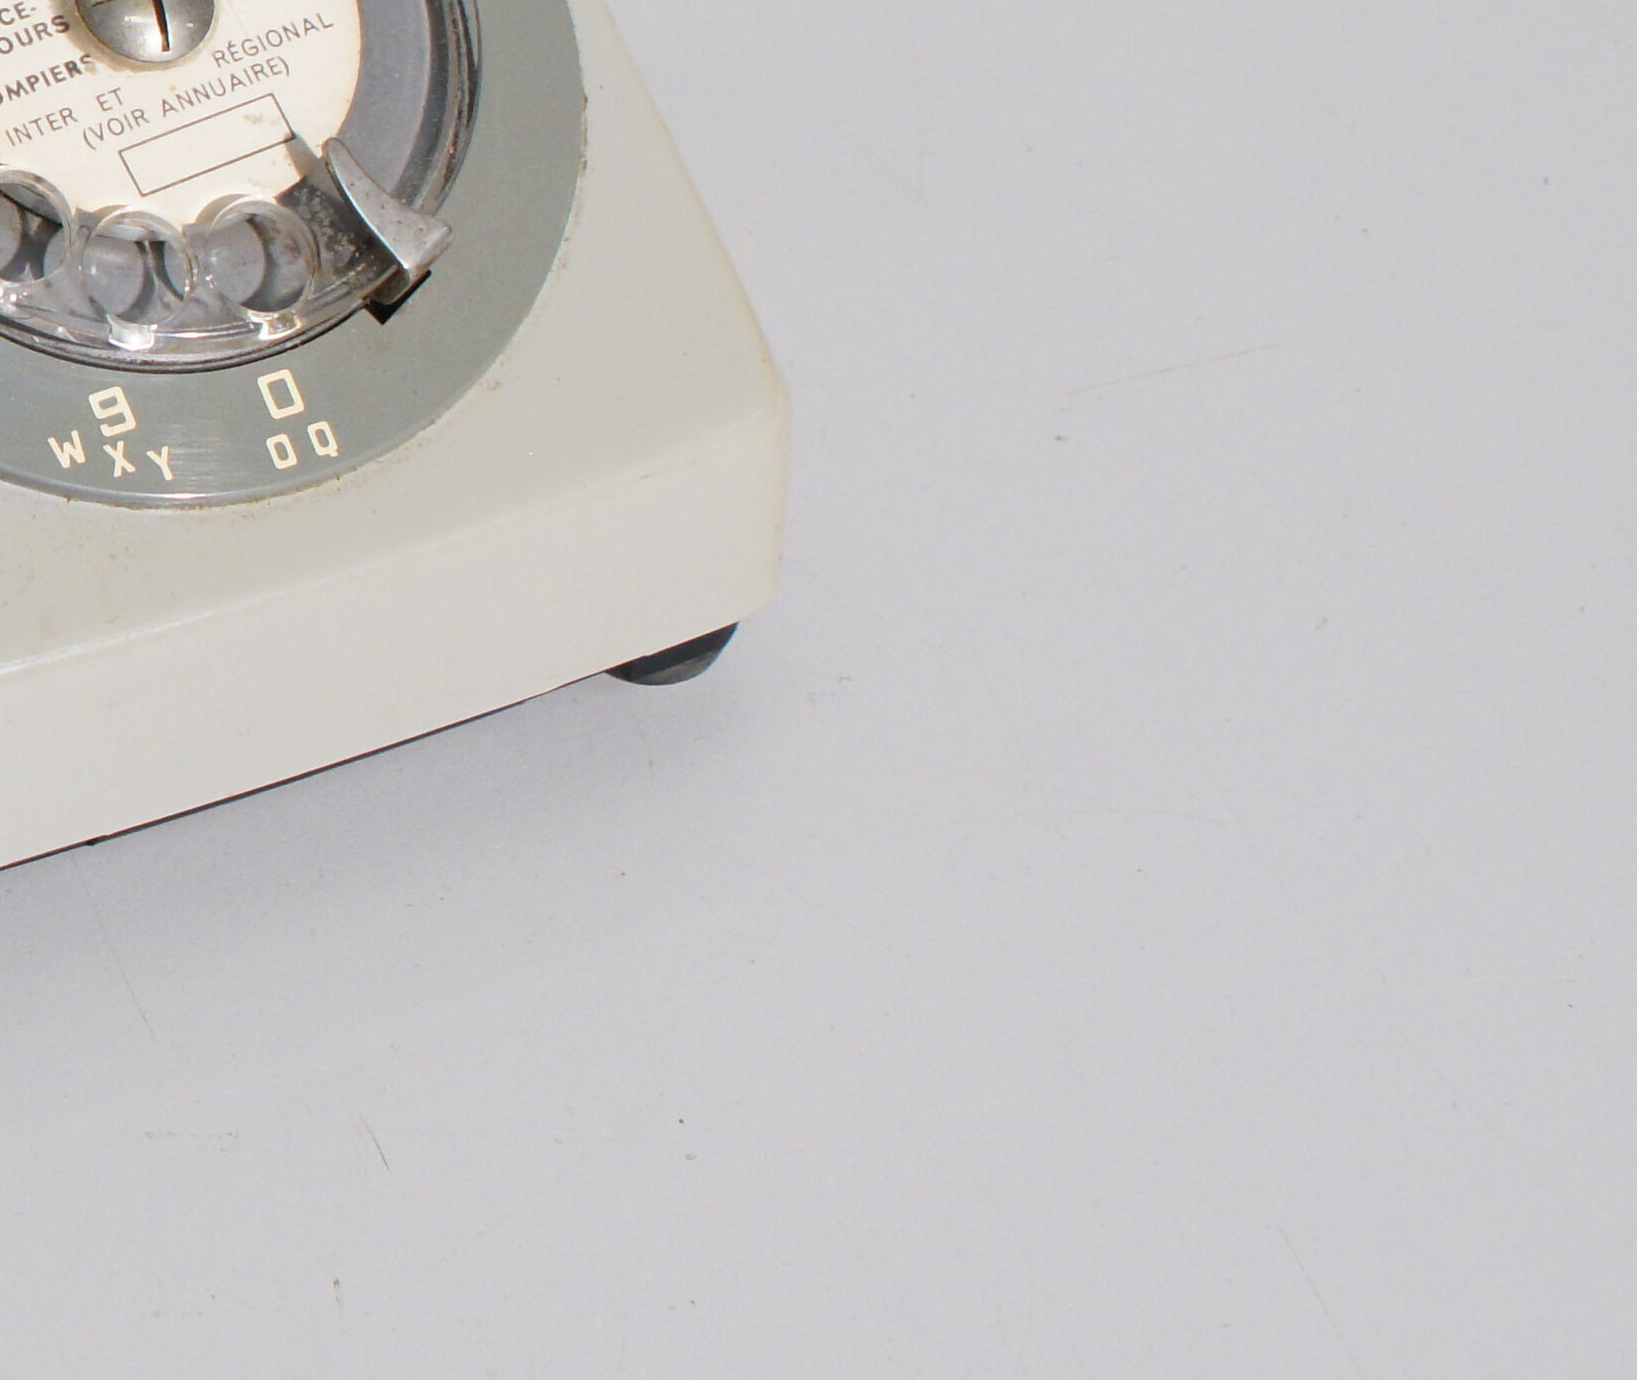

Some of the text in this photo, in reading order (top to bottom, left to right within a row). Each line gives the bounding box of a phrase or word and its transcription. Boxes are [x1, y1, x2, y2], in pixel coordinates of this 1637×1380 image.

[6, 13, 334, 147] INTER ET RÉGIONAL
[83, 56, 291, 150] (VOIR ANNUAIRE)
[88, 386, 137, 437] 9
